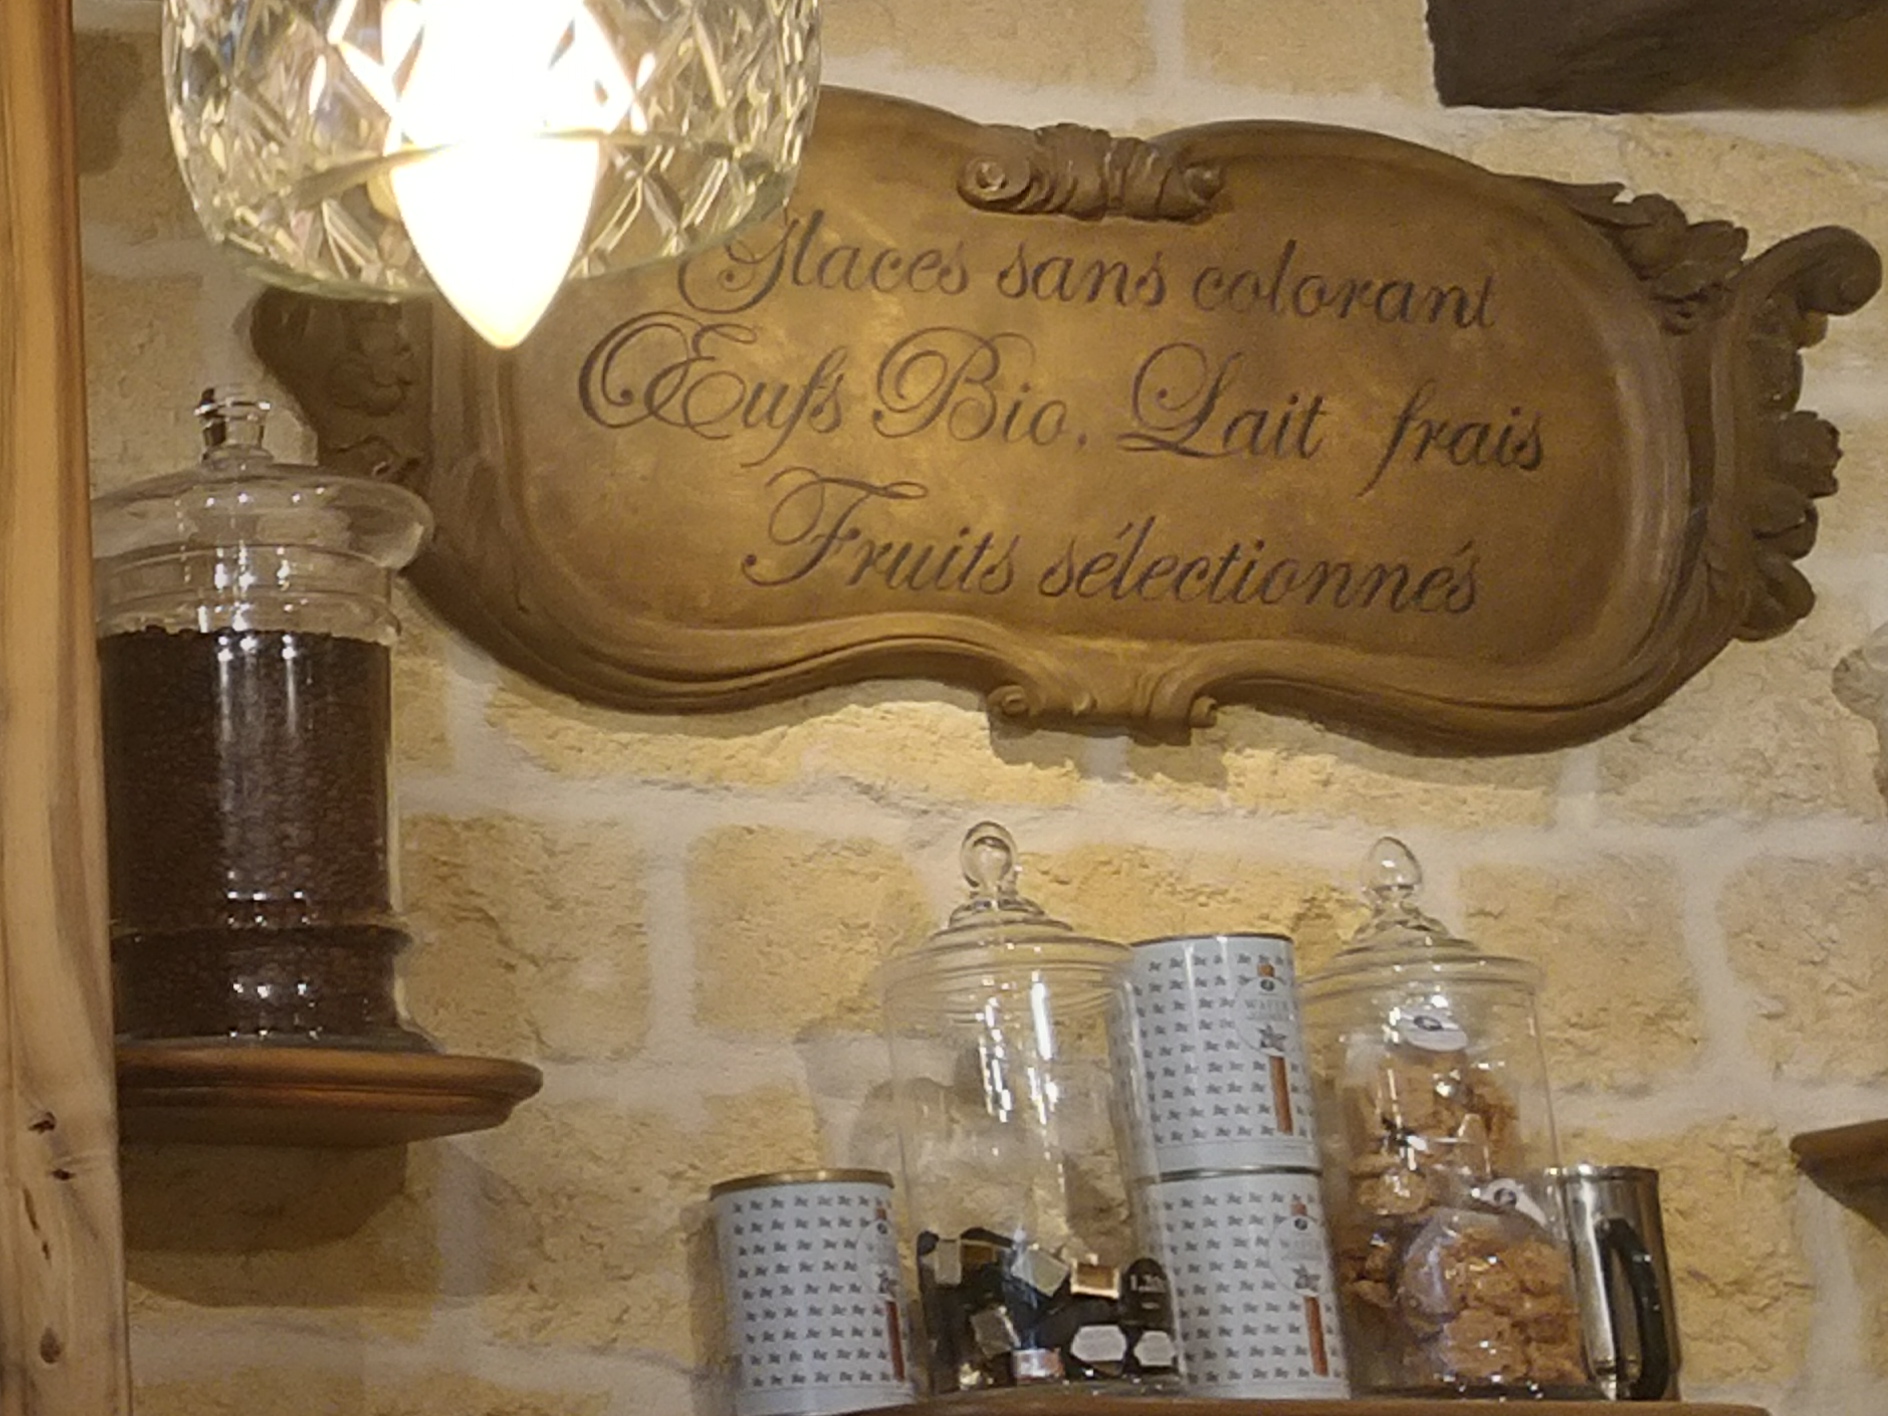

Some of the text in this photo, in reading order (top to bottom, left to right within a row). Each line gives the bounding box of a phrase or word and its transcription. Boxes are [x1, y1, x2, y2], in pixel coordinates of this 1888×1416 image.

[998, 237, 1166, 306] sans
[1192, 237, 1496, 331] colorant
[1117, 341, 1326, 459] Lait
[1357, 377, 1545, 496] frais
[741, 467, 1481, 618] Fruits sélectionnés
